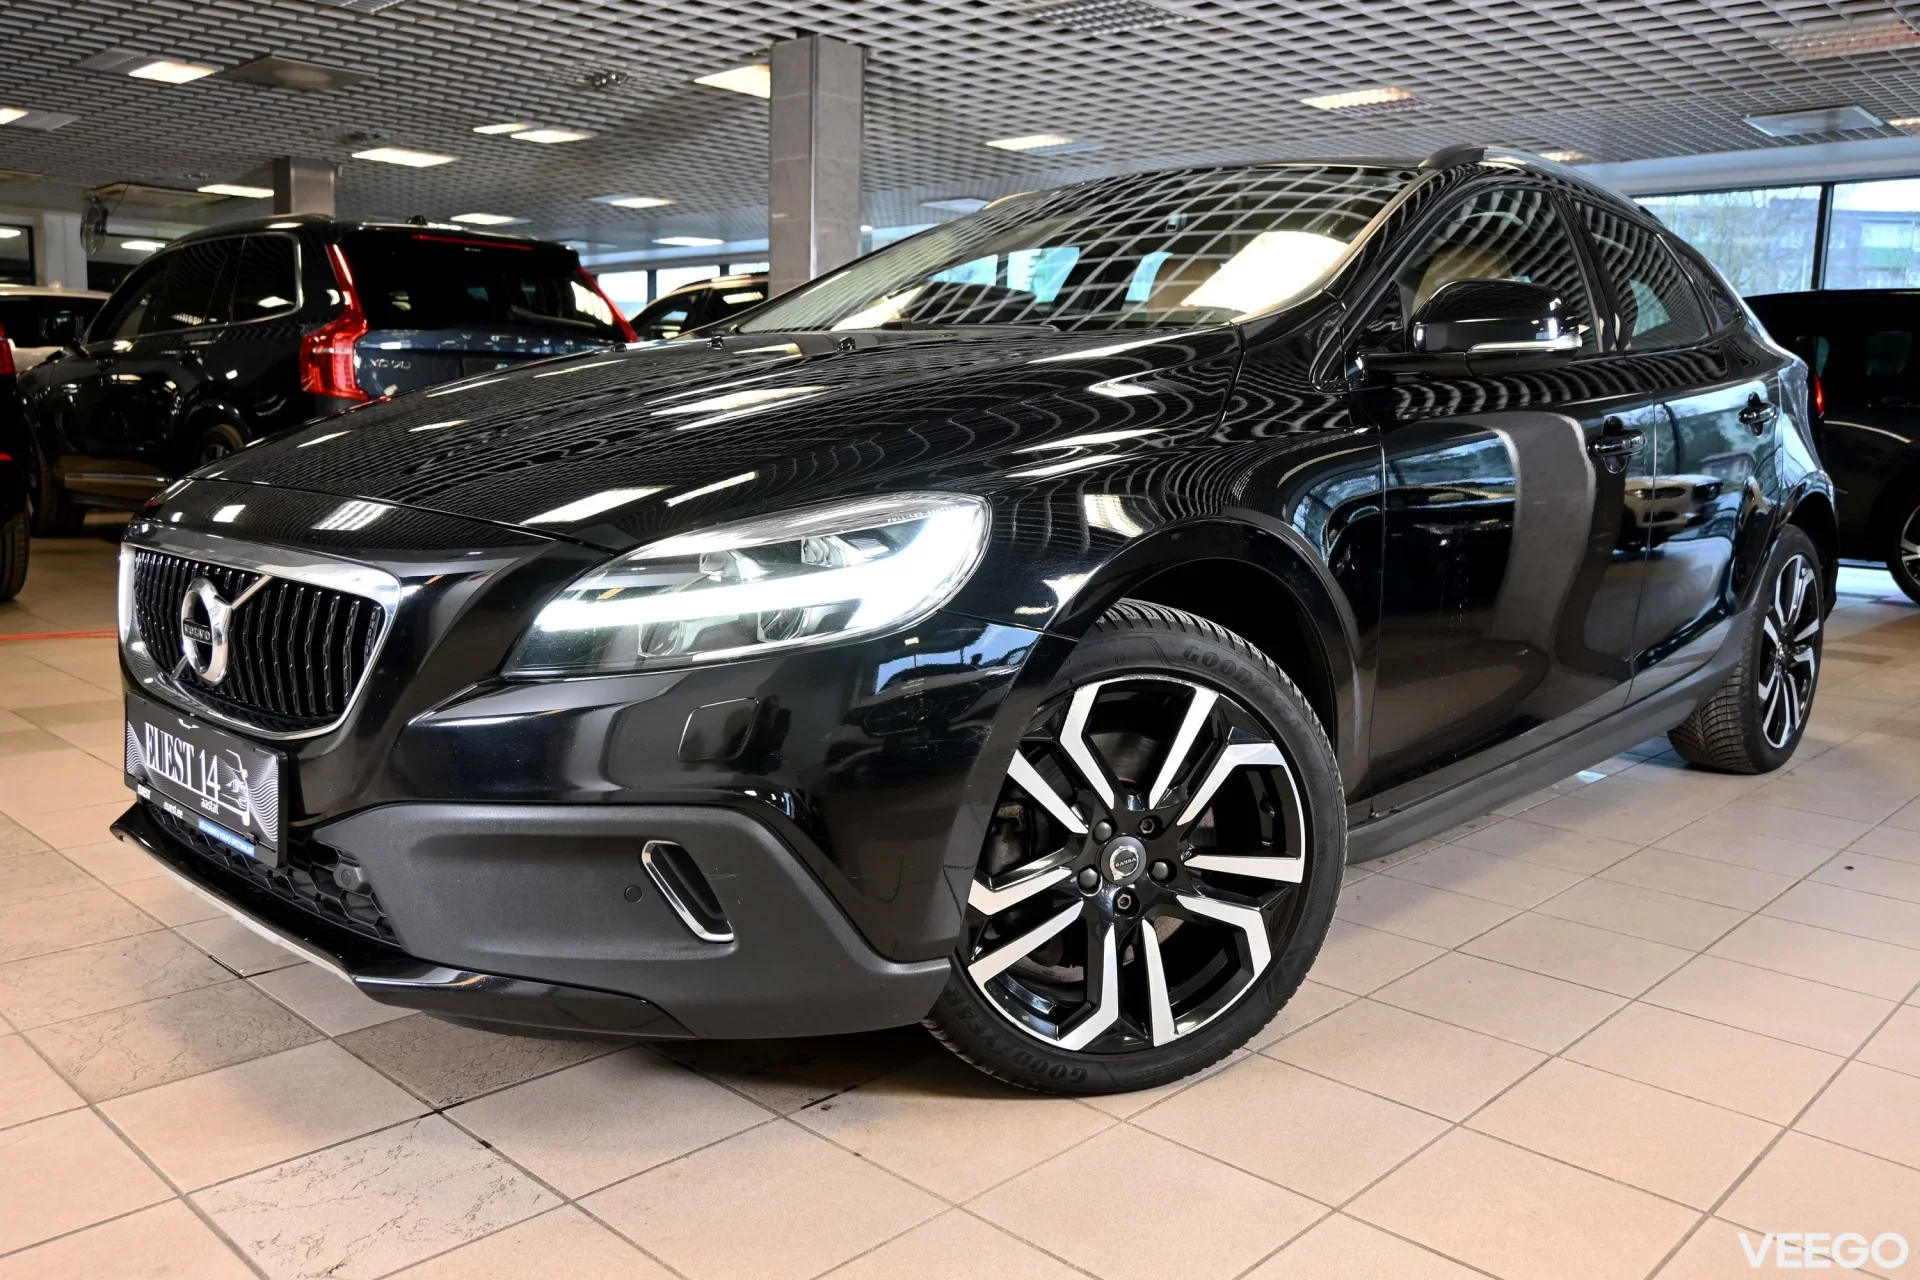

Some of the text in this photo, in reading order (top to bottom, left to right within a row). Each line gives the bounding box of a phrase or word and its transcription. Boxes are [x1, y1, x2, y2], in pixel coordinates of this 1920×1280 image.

[184, 624, 211, 641] VOLVO
[144, 721, 221, 801] EUEST 14
[1115, 857, 1137, 868] VOLVO
